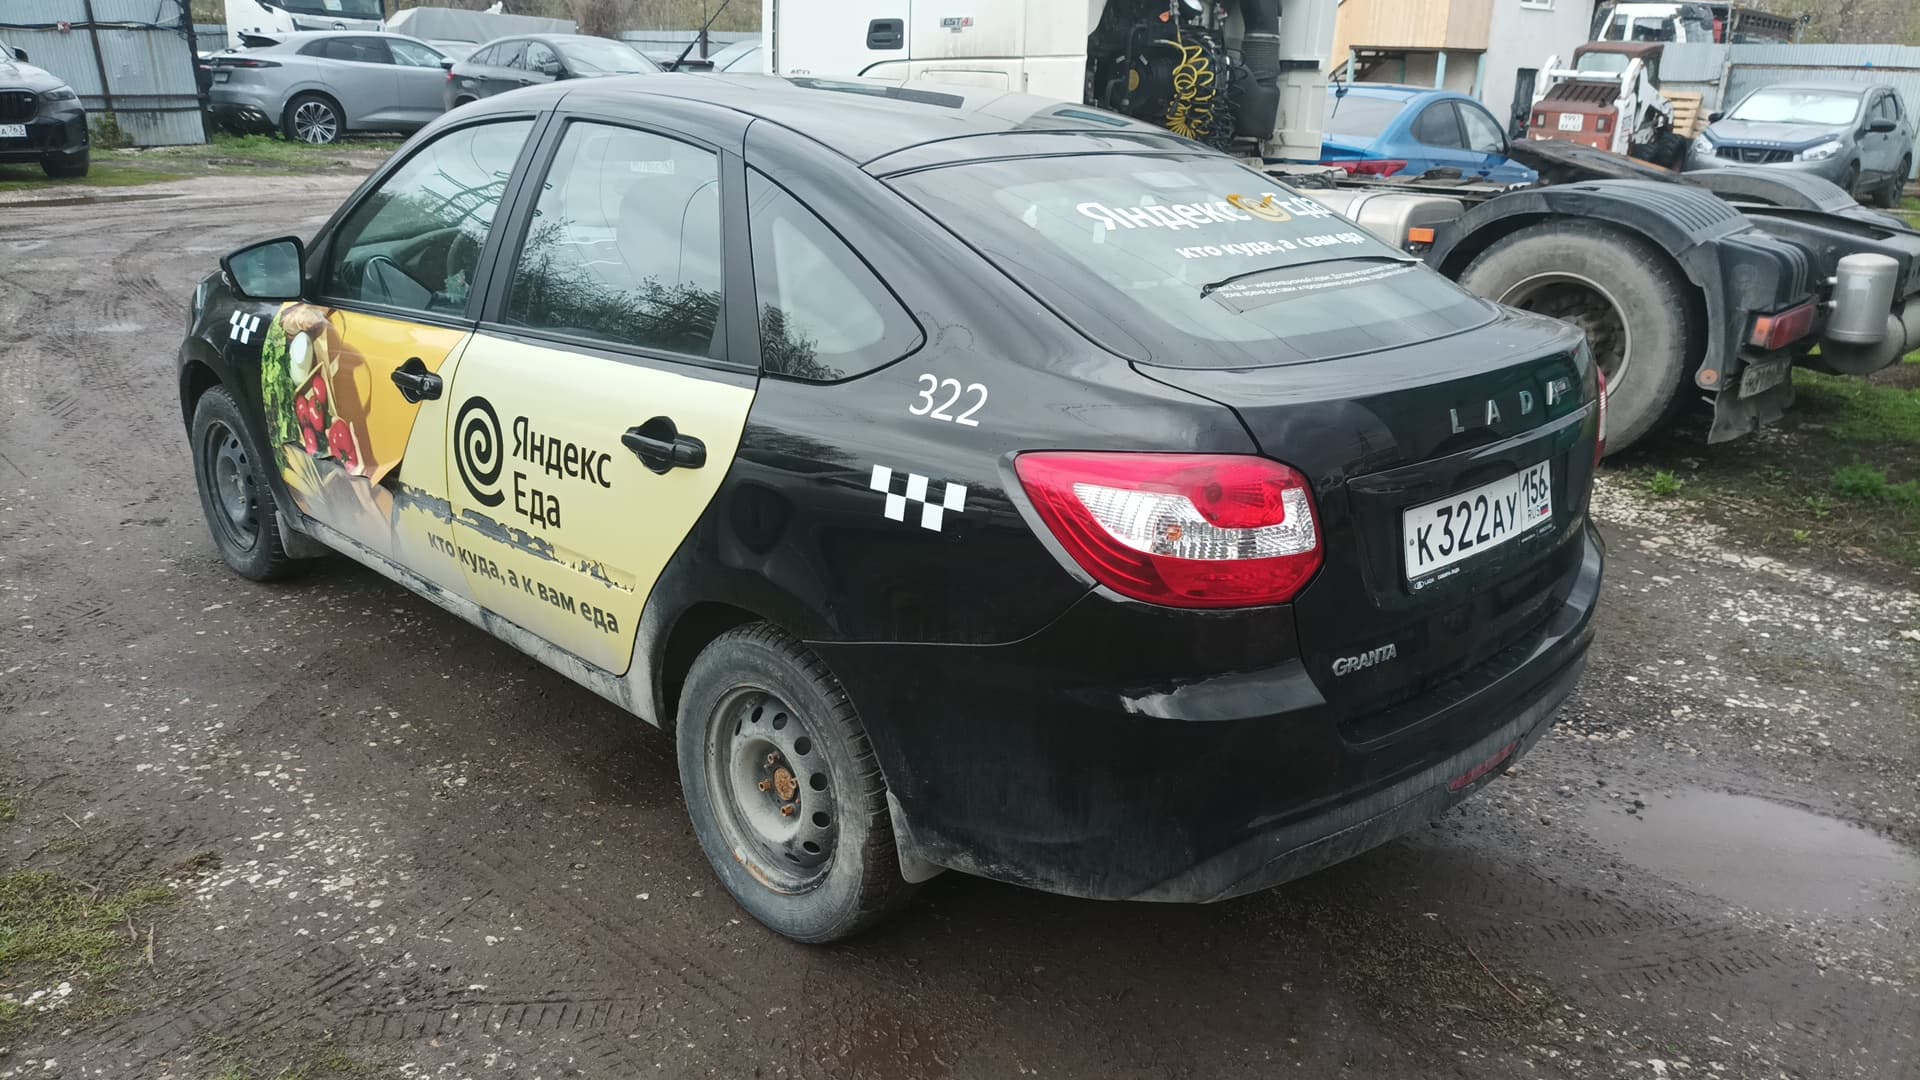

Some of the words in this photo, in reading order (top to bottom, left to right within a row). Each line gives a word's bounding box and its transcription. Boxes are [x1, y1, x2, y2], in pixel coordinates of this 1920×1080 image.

[1076, 201, 1253, 231] Яндекс
[1176, 245, 1223, 259] кто
[1278, 239, 1298, 250] а
[909, 373, 988, 427] 322
[1449, 381, 1564, 434] LADA
[512, 416, 612, 488] Яндекс
[513, 470, 561, 529] Еда
[1416, 493, 1518, 567] К322АУ
[1522, 465, 1549, 508] 156
[427, 531, 455, 557] кто
[457, 546, 506, 585] куда,
[509, 569, 520, 589] а
[523, 576, 535, 596] к
[538, 582, 576, 615] вам
[579, 601, 620, 634] еда
[1332, 643, 1397, 677] GRANTA
